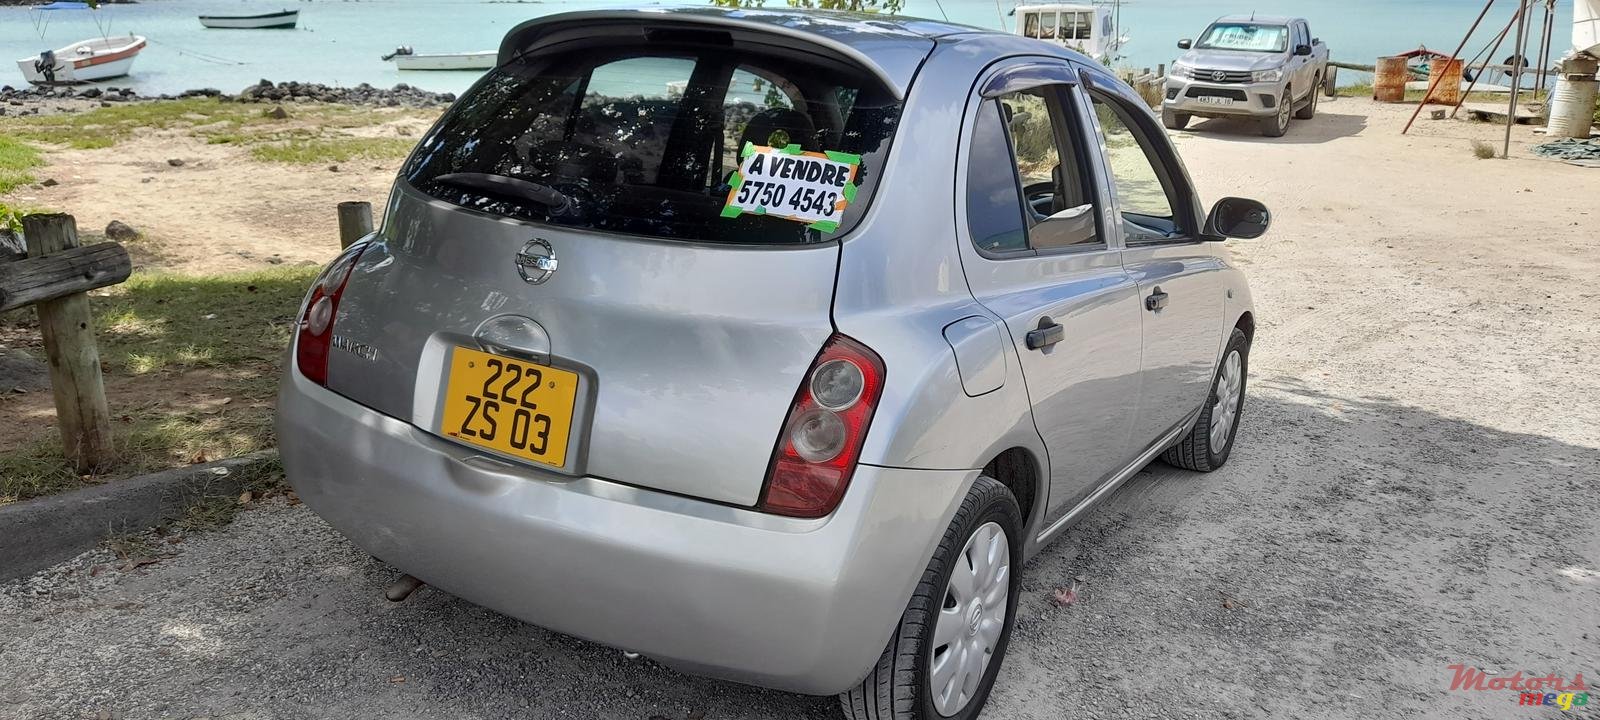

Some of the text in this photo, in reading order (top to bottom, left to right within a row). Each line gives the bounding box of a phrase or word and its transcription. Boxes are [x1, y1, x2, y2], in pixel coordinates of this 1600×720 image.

[749, 153, 850, 187] A VENDRE
[737, 180, 838, 217] 5750 4543
[482, 358, 542, 410] 222
[460, 395, 551, 456] ZS 03
